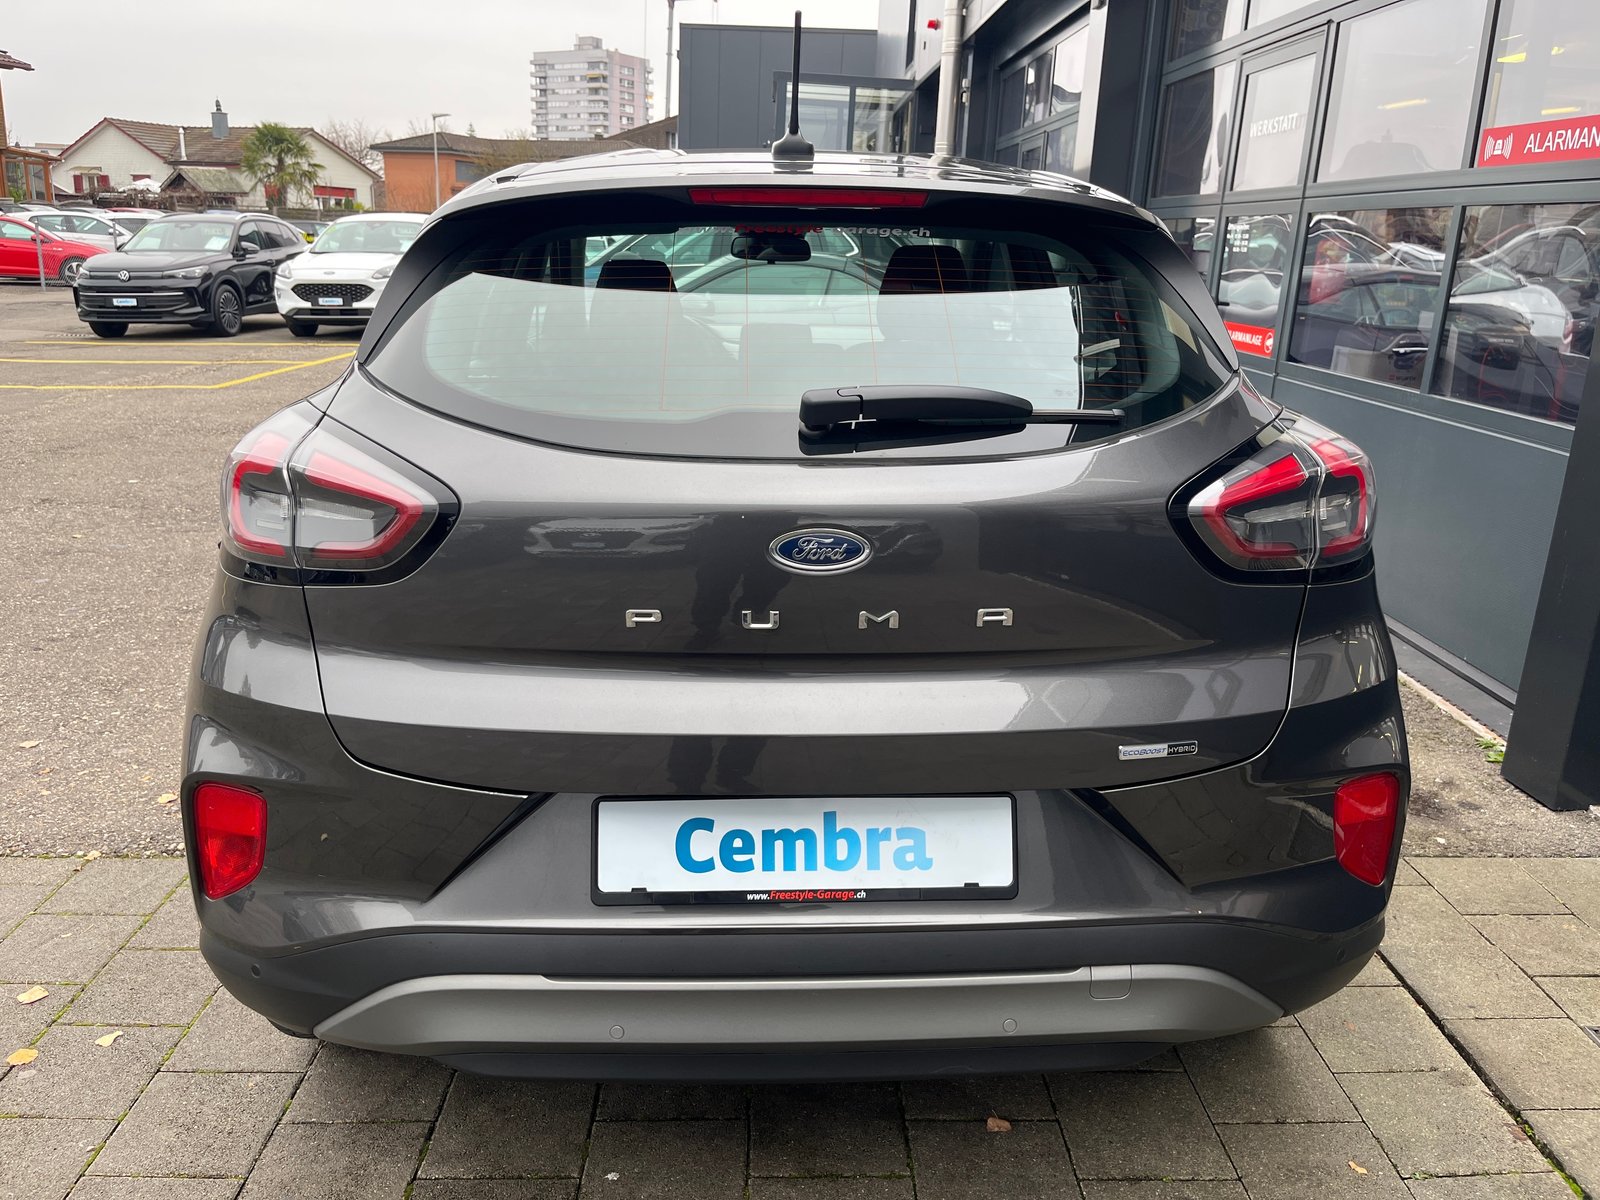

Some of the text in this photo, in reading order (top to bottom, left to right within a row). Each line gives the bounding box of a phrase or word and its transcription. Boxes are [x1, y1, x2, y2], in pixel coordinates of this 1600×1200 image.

[1249, 112, 1298, 138] WERKSTATT
[1523, 126, 1600, 154] ALARMAN
[791, 536, 848, 560] Ford
[625, 607, 1014, 629] PUMA
[1168, 744, 1196, 754] HYBRID
[674, 810, 934, 874] Cembra
[746, 889, 867, 902] www.Freestyle-Garage.ch
